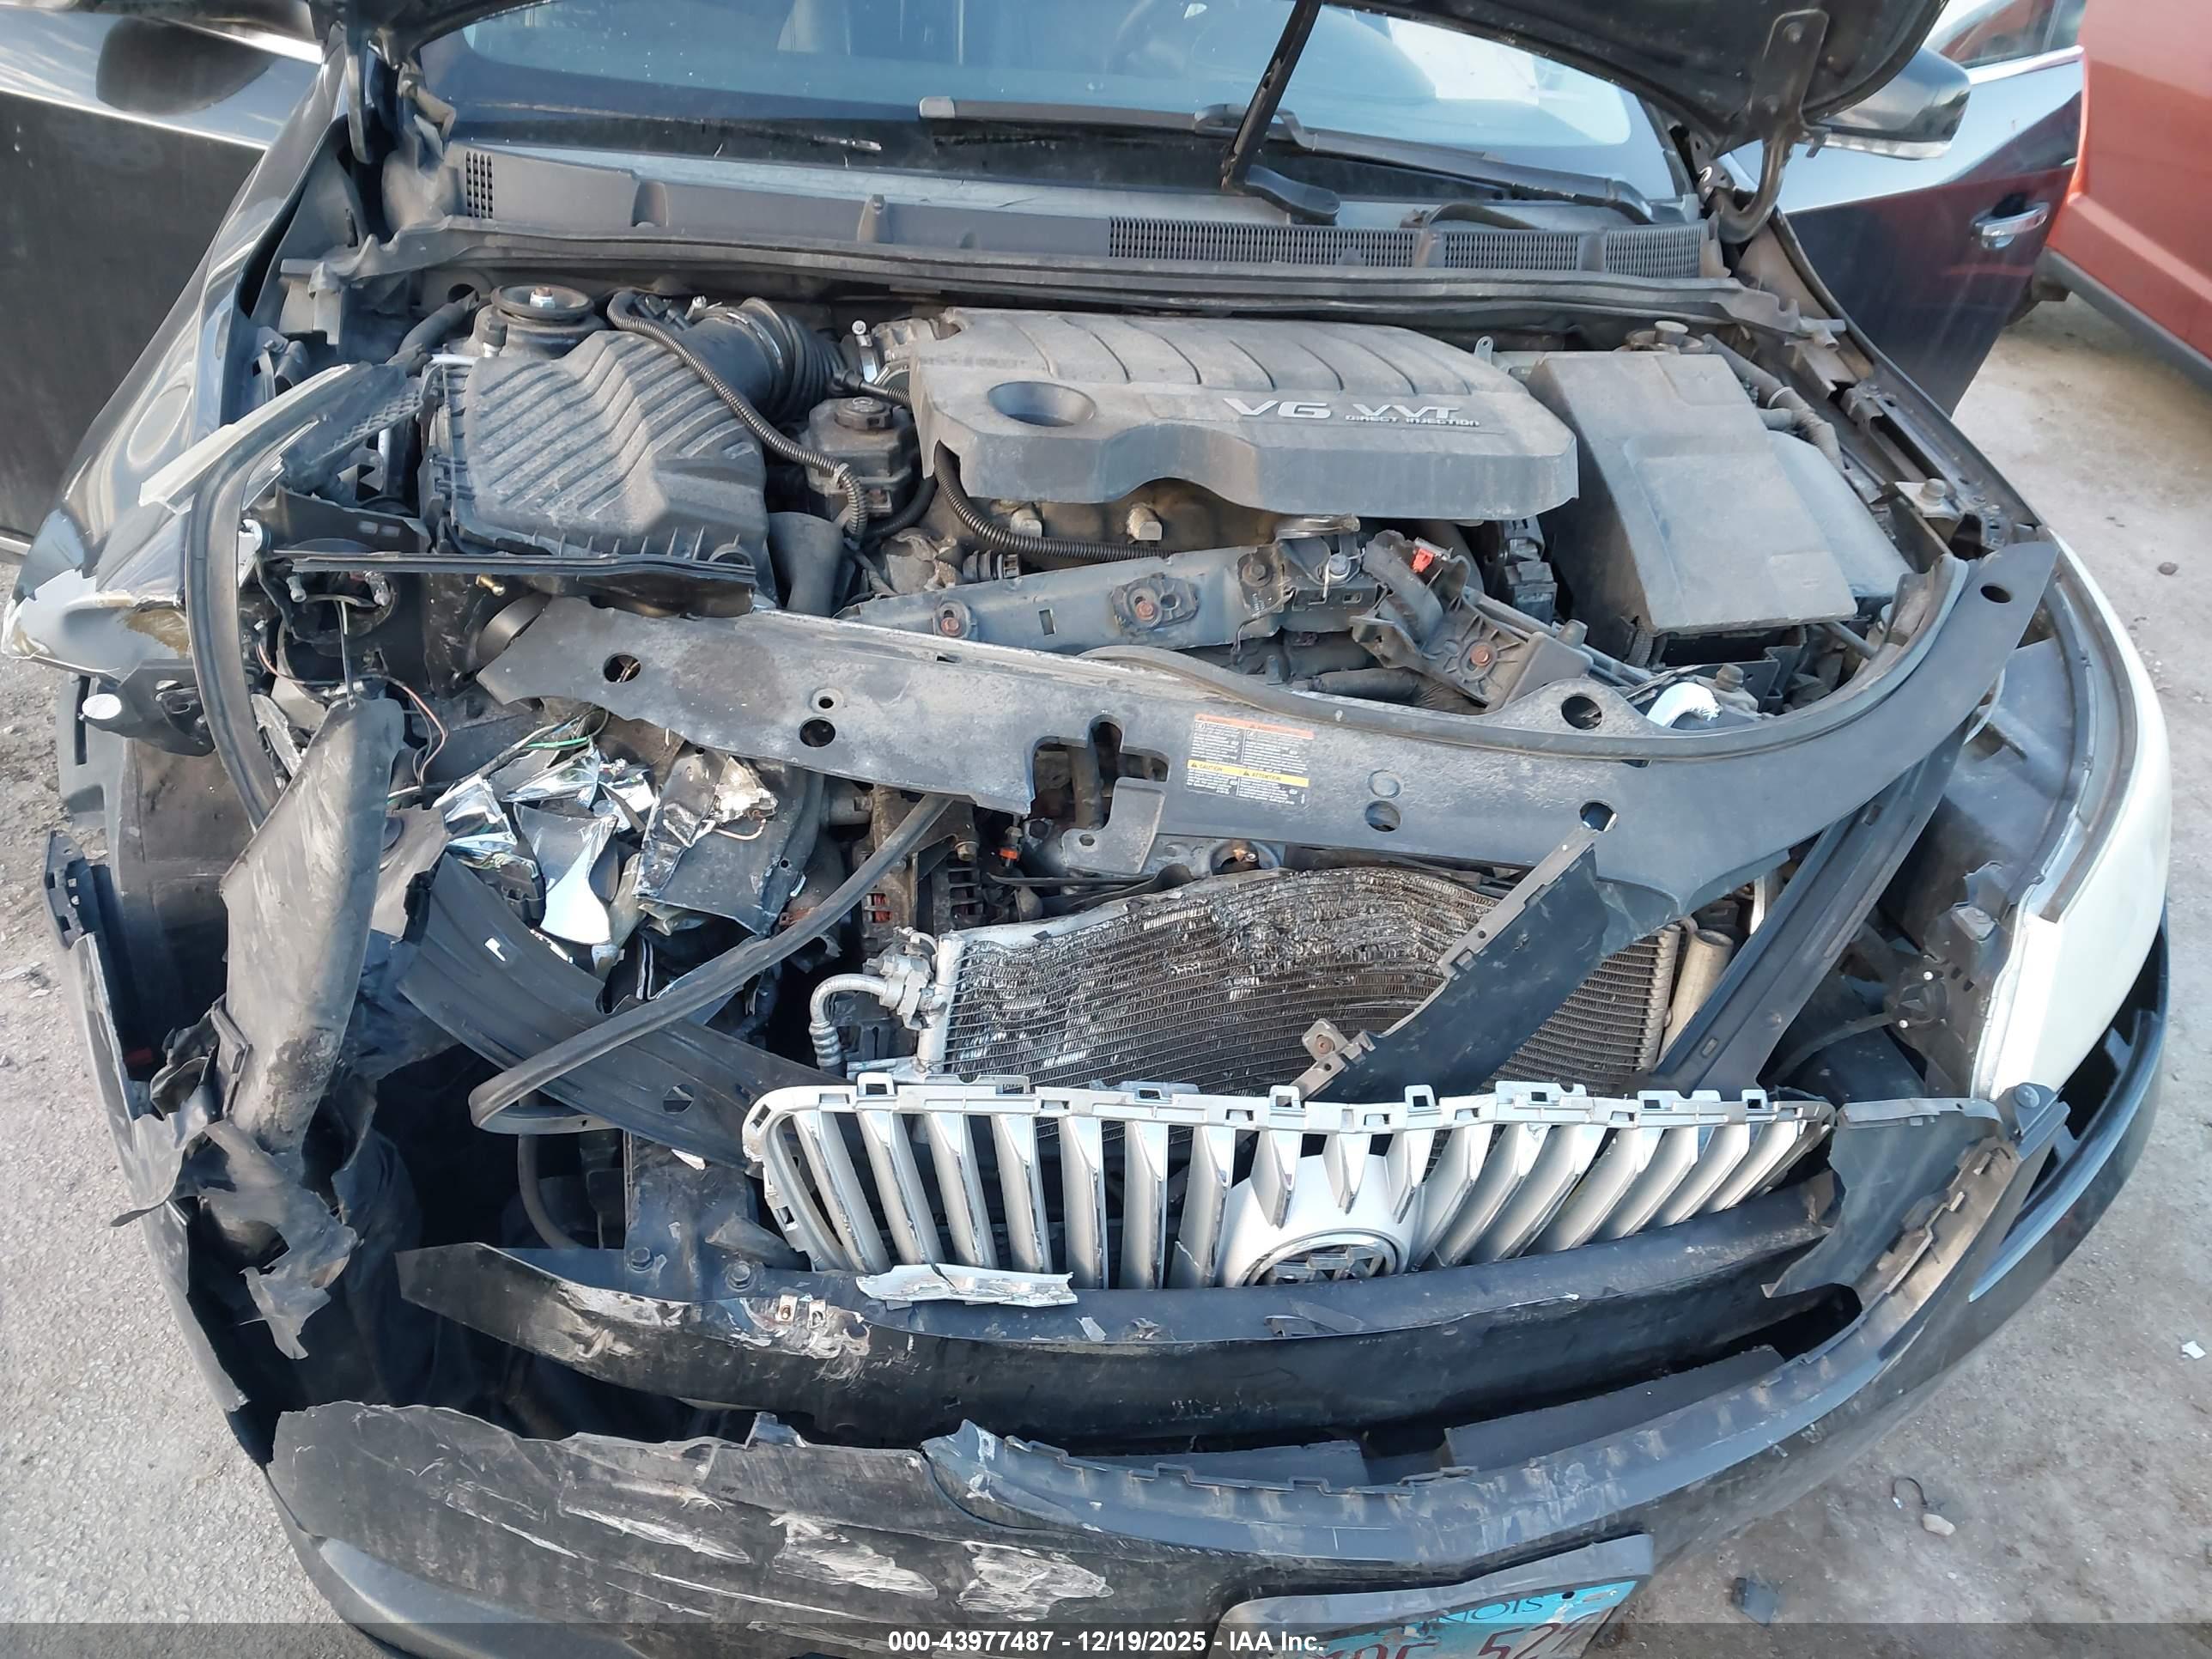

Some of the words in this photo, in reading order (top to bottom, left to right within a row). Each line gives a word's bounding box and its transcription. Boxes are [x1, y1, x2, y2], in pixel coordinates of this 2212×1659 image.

[1223, 398, 1332, 419] V6
[1352, 404, 1460, 419] VVT
[1345, 415, 1399, 423] DIRECT
[1406, 417, 1480, 428] INJECTION
[1199, 763, 1223, 772] CAUTION
[1251, 771, 1282, 781] ATTENTION
